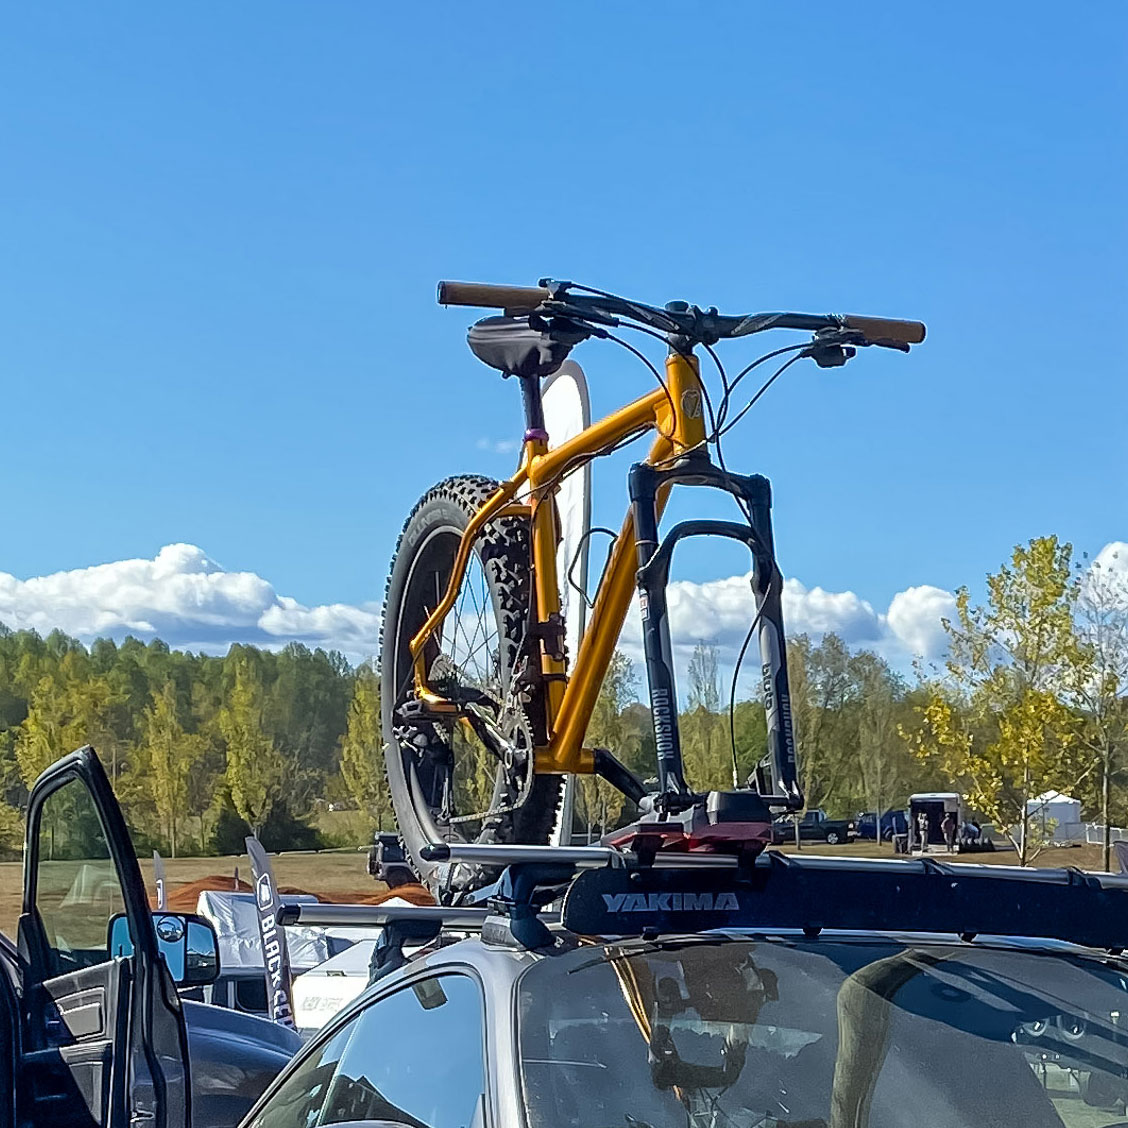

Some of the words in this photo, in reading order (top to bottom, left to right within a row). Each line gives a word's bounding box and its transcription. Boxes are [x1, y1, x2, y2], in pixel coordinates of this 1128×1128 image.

[651, 688, 674, 761] ROCKSHOX
[601, 892, 740, 913] YAKIMA
[261, 914, 281, 987] BLACK
